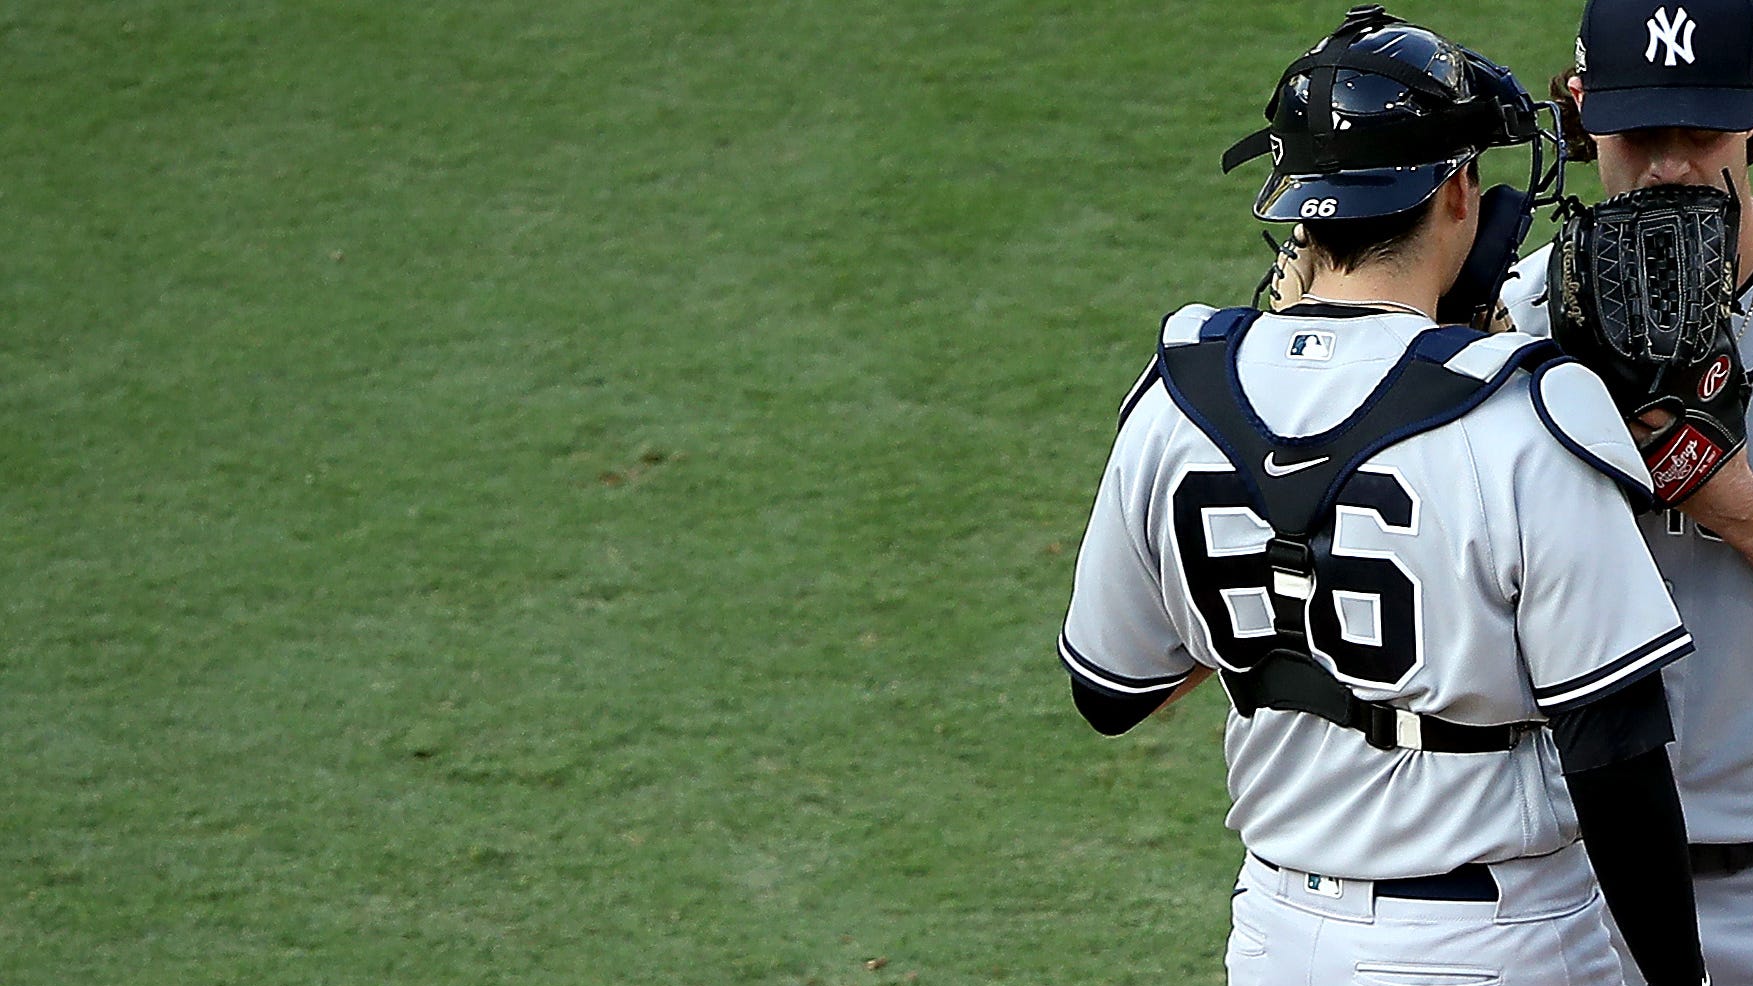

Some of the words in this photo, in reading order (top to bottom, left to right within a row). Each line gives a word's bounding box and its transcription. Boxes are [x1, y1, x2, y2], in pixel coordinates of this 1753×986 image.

[1645, 6, 1697, 67] NY
[1300, 198, 1338, 218] 66
[1653, 439, 1698, 489] Rawlings
[1167, 463, 1425, 691] 66
